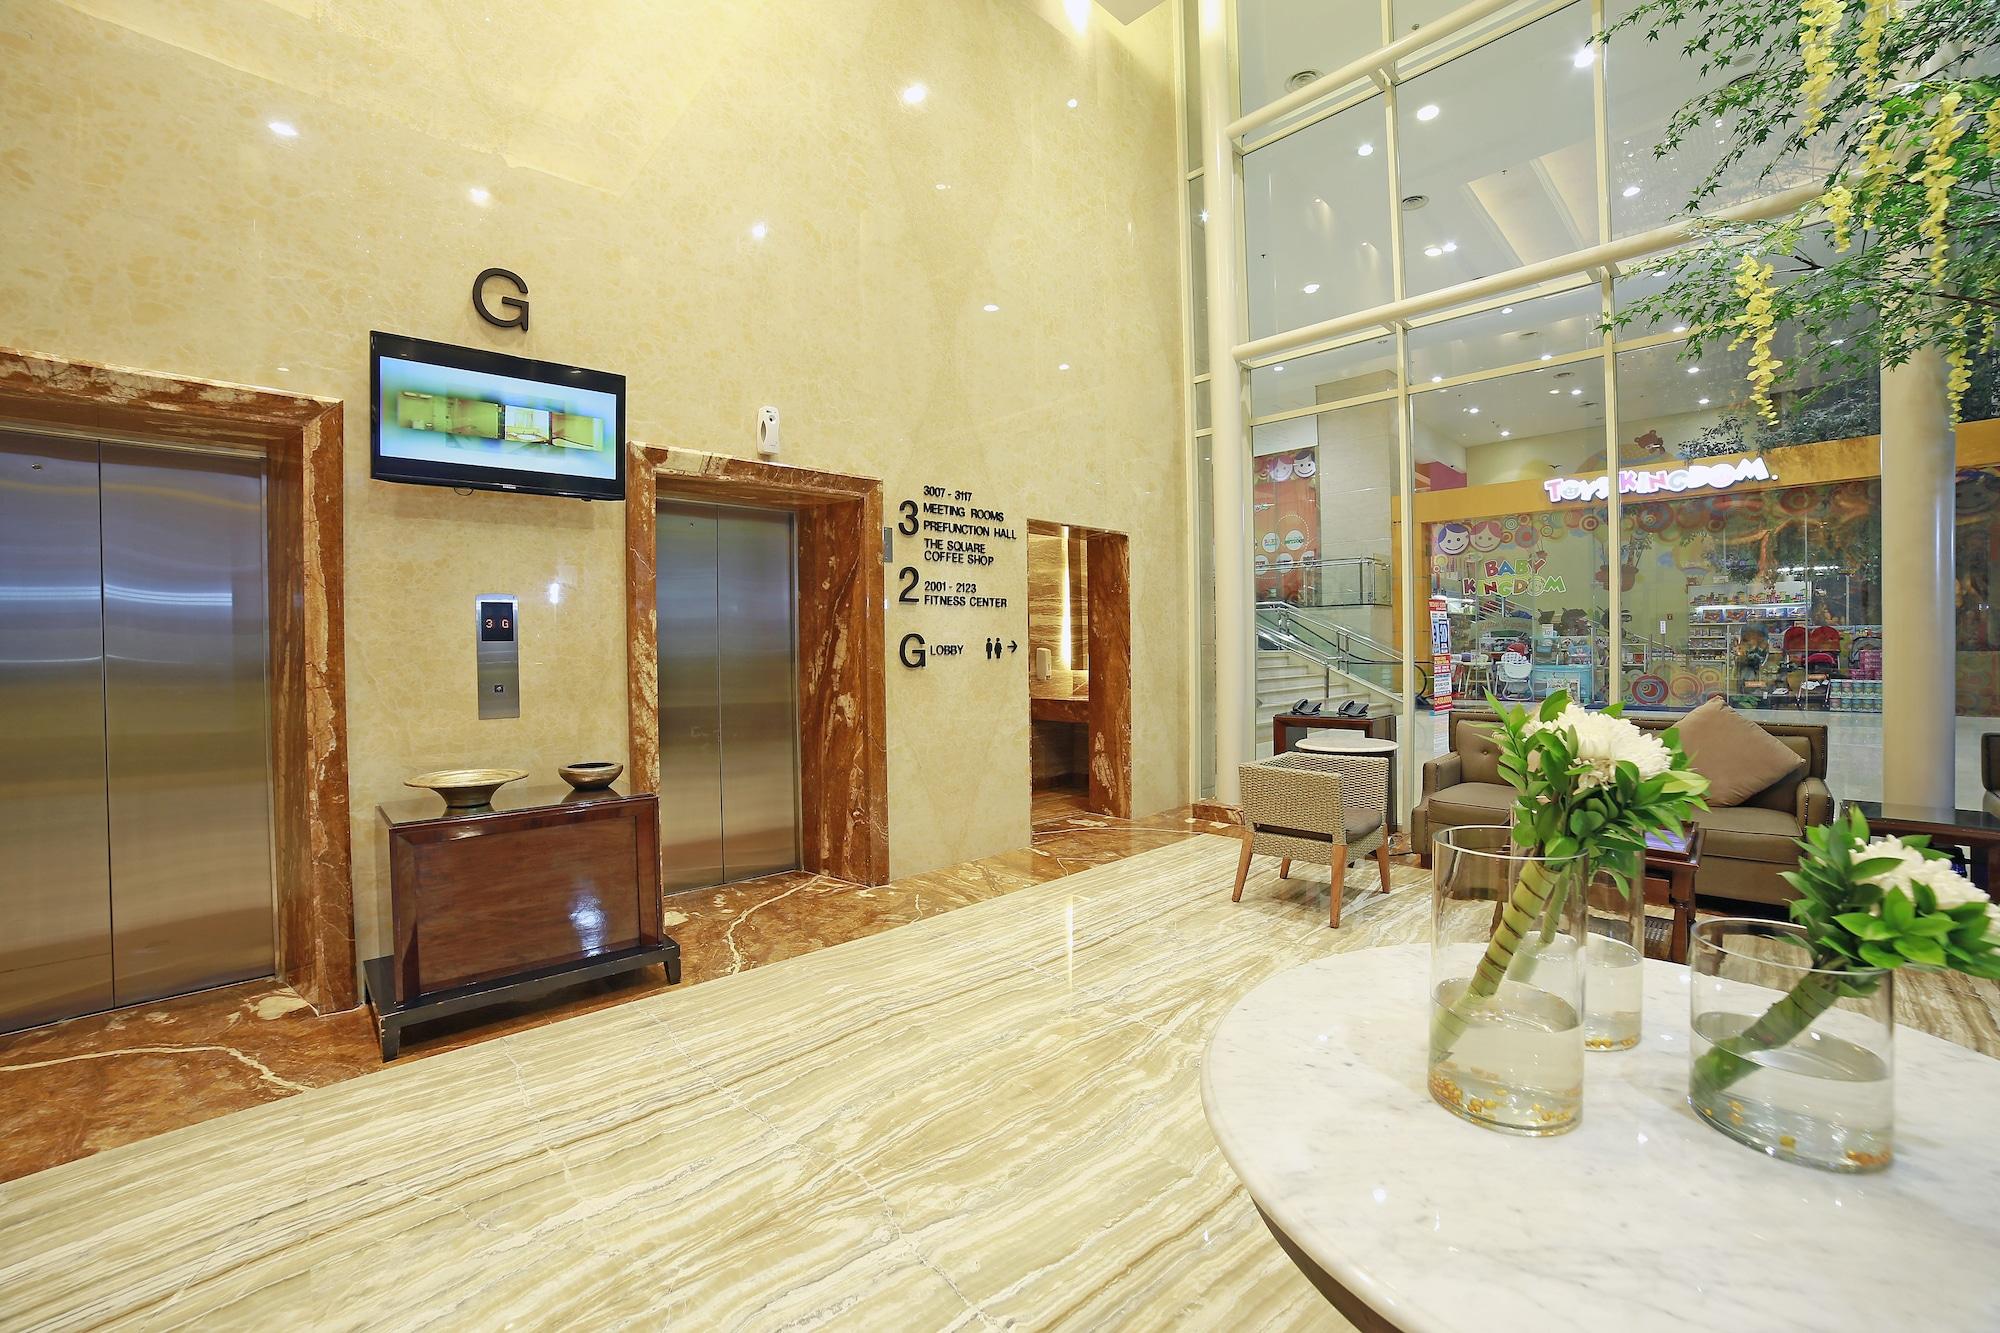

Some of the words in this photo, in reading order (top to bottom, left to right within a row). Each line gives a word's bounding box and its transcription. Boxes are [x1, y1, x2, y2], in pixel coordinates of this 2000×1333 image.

[472, 267, 529, 332] G
[923, 485, 946, 498] 3007
[954, 490, 973, 501] 3117
[1544, 476, 1608, 502] TOYS
[898, 500, 920, 536] 3
[923, 502, 965, 517] MEETING
[970, 508, 1004, 522] ROOMS
[923, 520, 990, 536] PREFUNCTION
[993, 527, 1017, 540] HALL
[924, 538, 944, 550] THE
[946, 540, 986, 554] SQUARE
[924, 550, 964, 563] COFFEE
[967, 554, 994, 566] SHOP
[1485, 559, 1546, 578] BABY
[899, 566, 919, 602] 2
[924, 581, 946, 591] 2001
[956, 583, 977, 593] 2123
[1463, 575, 1566, 597] KINGDOM
[924, 595, 966, 606] FITNESS
[969, 597, 1007, 608] CENTER
[485, 619, 493, 629] 3
[501, 619, 509, 629] G
[899, 633, 926, 668] G
[930, 645, 964, 656] LOBBY
